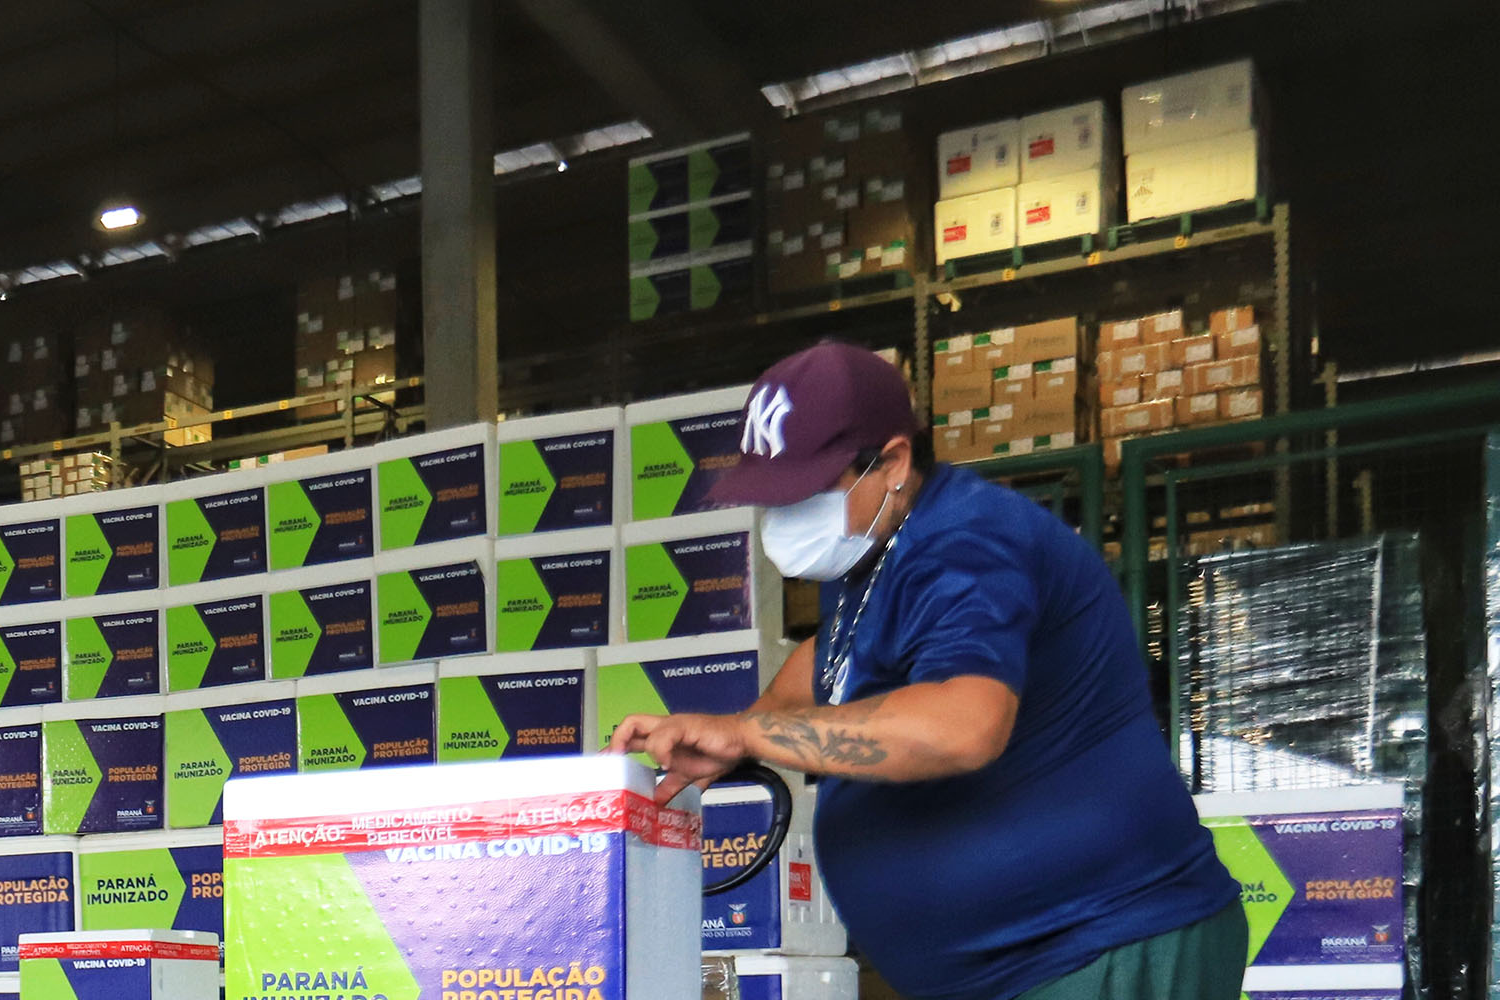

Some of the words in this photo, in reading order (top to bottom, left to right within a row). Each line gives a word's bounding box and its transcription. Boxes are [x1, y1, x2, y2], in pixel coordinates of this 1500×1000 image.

[662, 665, 703, 678] VACINA
[704, 660, 752, 675] COVID-19
[497, 679, 533, 690] VACINA
[535, 677, 578, 688] COVID-19
[352, 696, 387, 707] VACINA
[388, 691, 429, 703] COVID-19
[220, 712, 251, 722] VACINA
[253, 707, 291, 719] COVID-19
[91, 723, 122, 733] VACINA
[516, 726, 576, 739] POPULAÇÃO
[3, 730, 38, 740] COVID-19
[450, 729, 491, 741] PARANÁ
[516, 735, 575, 746] PROTEGIDA
[373, 738, 429, 751] POPULAÇÃO
[443, 739, 499, 750] IMUNIZADO
[311, 745, 349, 757] PARANÁ
[373, 747, 429, 759] PROTEGIDA
[239, 752, 291, 765] POPULAÇÃO
[304, 753, 356, 766] IMUNIZADO
[108, 764, 158, 774] POPULAÇÃO
[180, 760, 216, 770] PARANÁ
[239, 761, 291, 773] PROTEGIDA
[53, 767, 87, 777] PARANÁ
[108, 772, 158, 782] PROTEGIDA
[174, 768, 223, 779] IMUNIZADO
[116, 808, 143, 817] PARANÁ
[254, 826, 345, 847] ATENÇÃO:
[351, 808, 472, 830] MEDICAMENTO
[1274, 823, 1327, 834] VACINA
[1331, 820, 1396, 832] COVID-19
[367, 824, 458, 846] PERECÍVEL
[385, 842, 481, 862] VACINA
[488, 833, 608, 858] COVID-19
[97, 873, 157, 890] PARANÁ
[1305, 877, 1394, 891] POPULAÇÃO
[87, 889, 169, 906] IMUNIZADO
[1305, 889, 1394, 901] PROTEGIDA
[1321, 936, 1367, 946] PARANÁ
[73, 961, 106, 969] VACINA
[107, 959, 146, 968] COVID-19
[262, 966, 368, 991] PARANÁ
[442, 962, 605, 989] POPULAÇÃO
